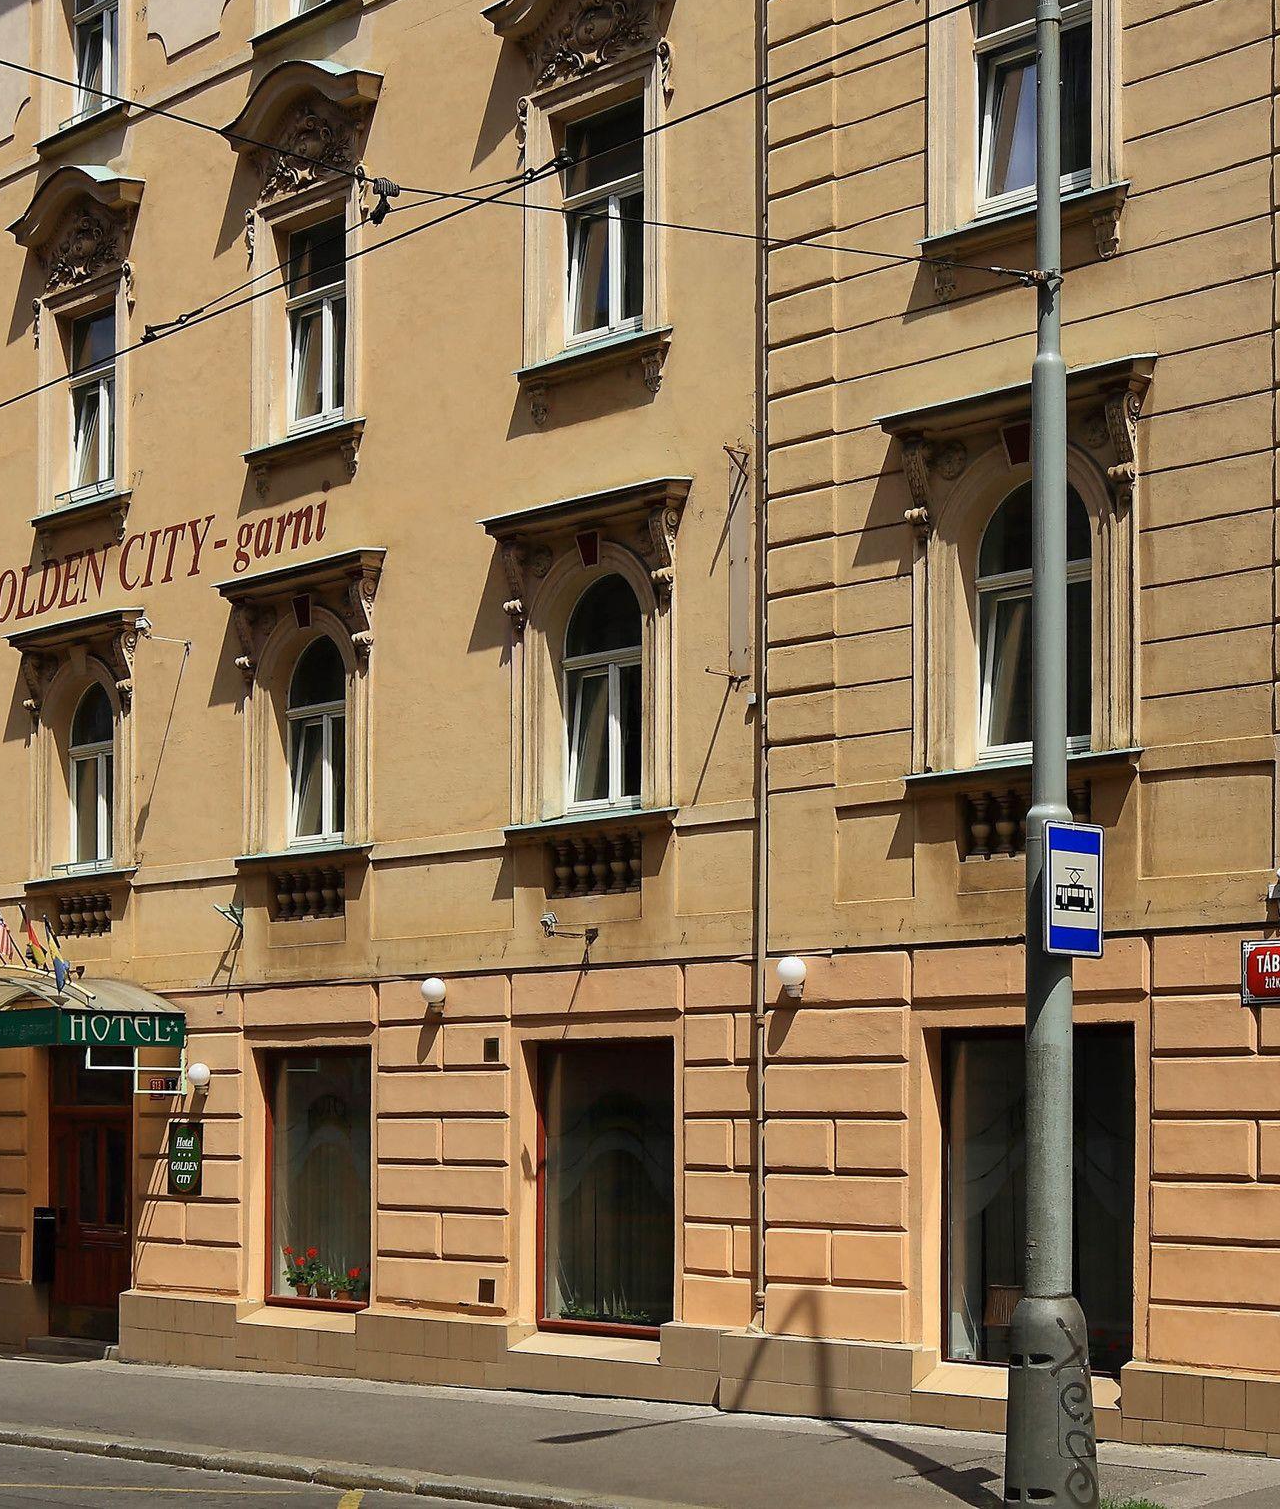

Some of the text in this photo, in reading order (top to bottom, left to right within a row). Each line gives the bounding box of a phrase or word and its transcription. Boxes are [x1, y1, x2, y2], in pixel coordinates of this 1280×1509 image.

[120, 514, 215, 591] CITY
[232, 480, 331, 574] garni
[70, 1014, 171, 1042] HOTEL
[176, 1136, 194, 1147] Hotel
[171, 1161, 198, 1171] GOLDEN
[176, 1174, 192, 1184] CITY
